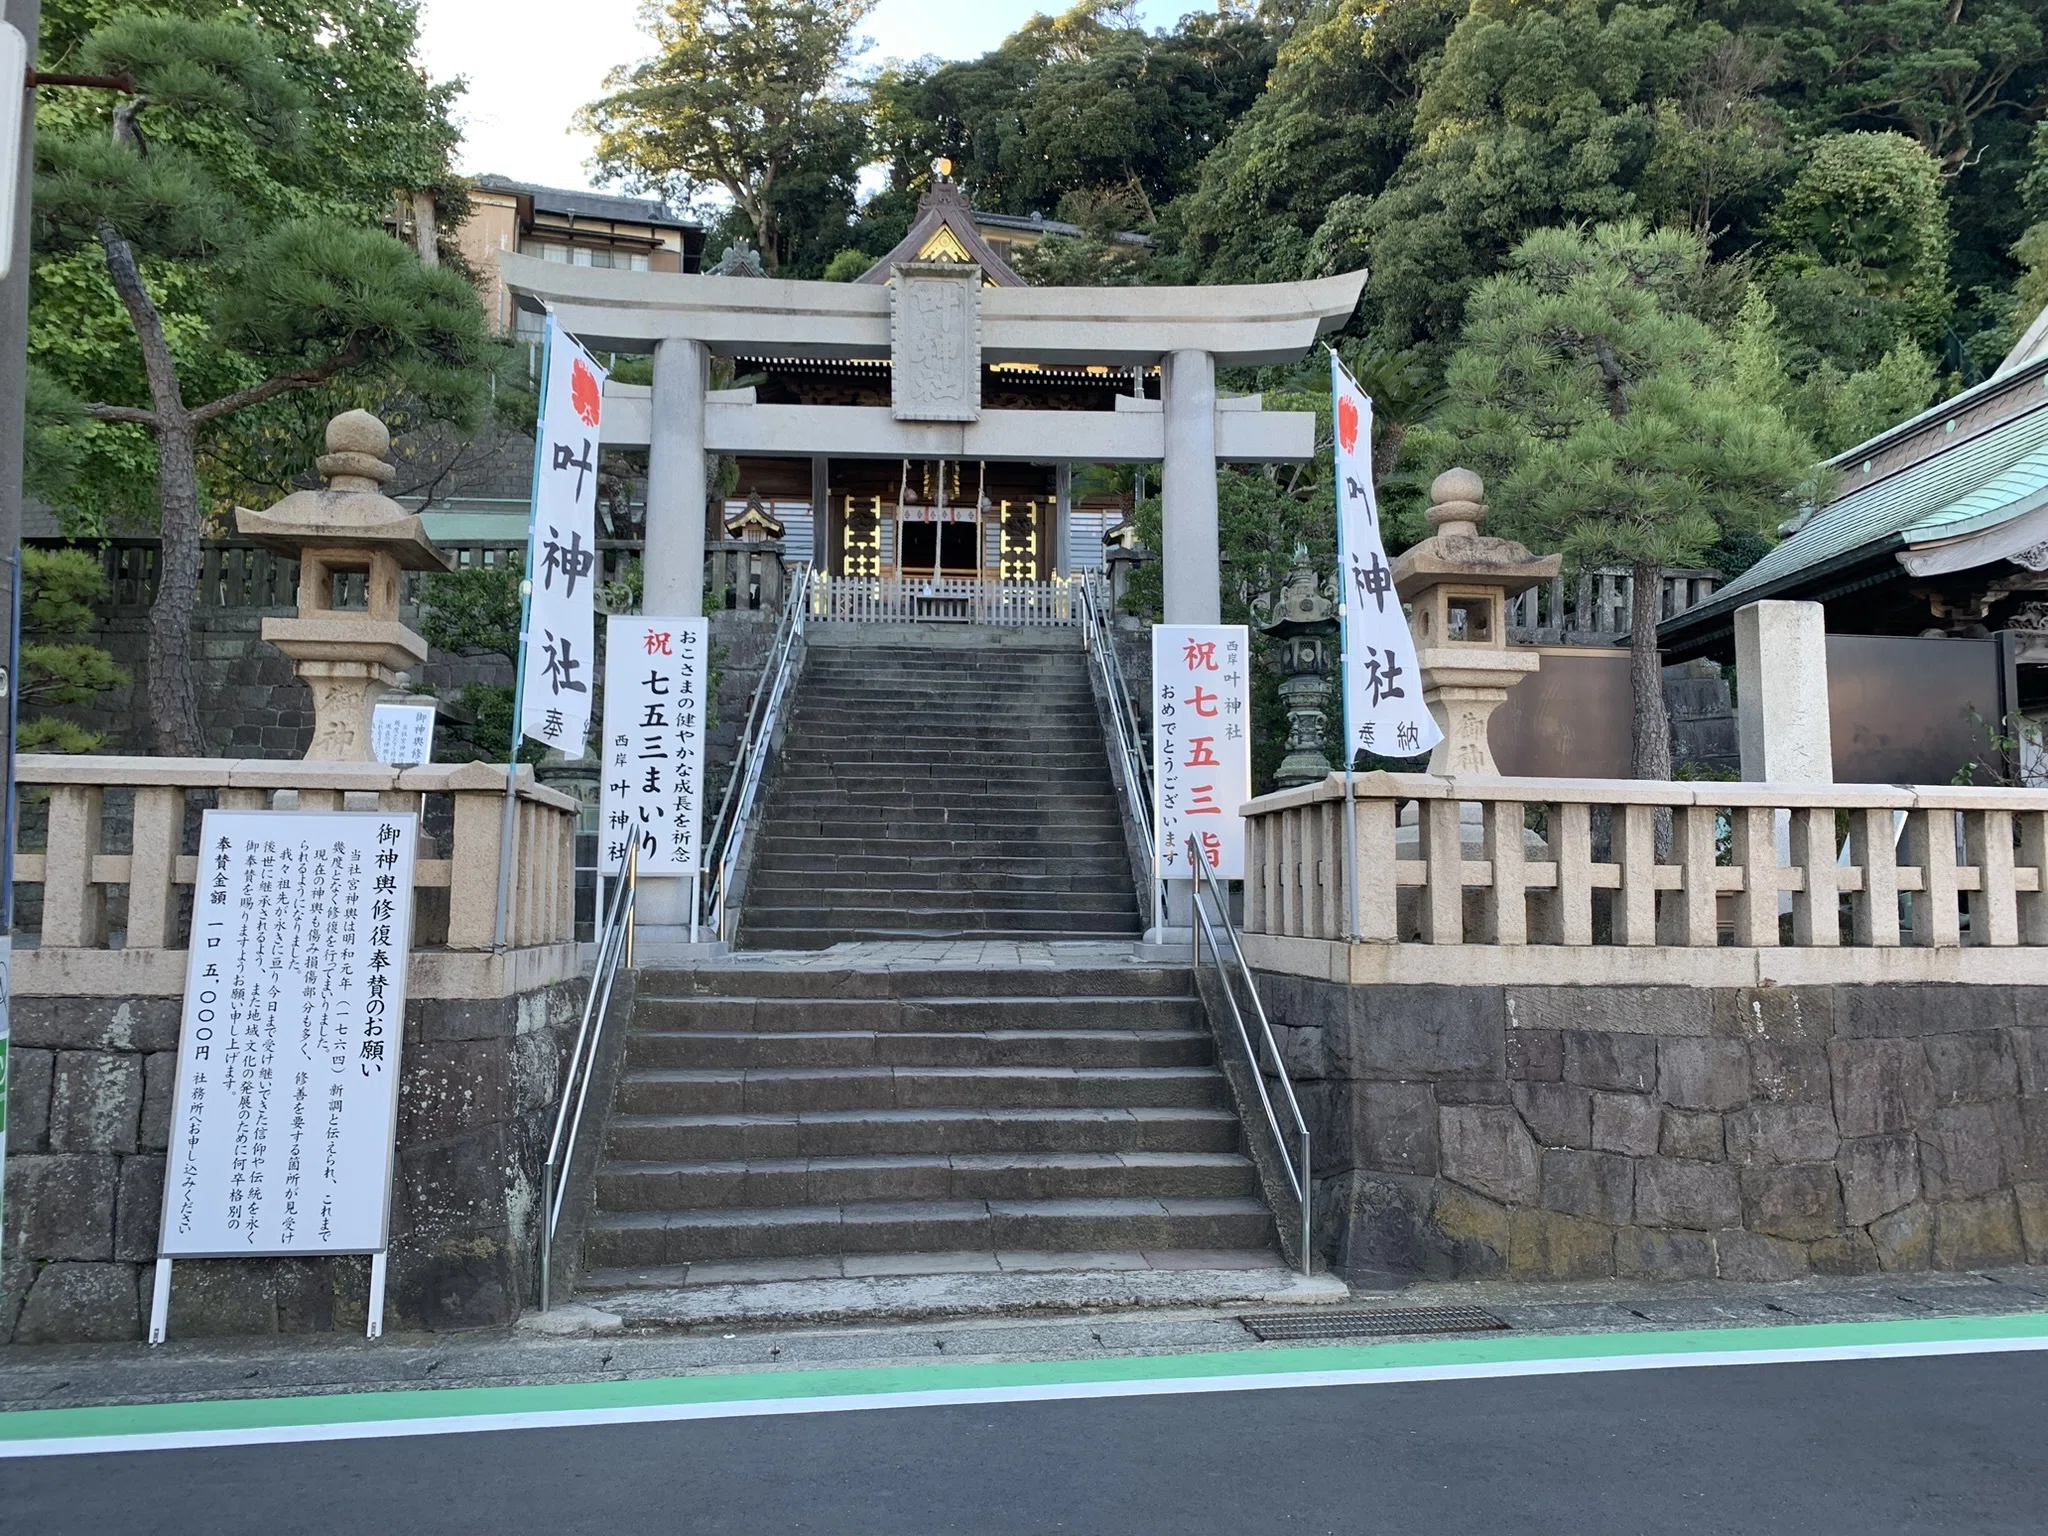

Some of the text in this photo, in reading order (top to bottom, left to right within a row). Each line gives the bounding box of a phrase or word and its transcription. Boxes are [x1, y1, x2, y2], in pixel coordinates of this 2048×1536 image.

[541, 438, 594, 696] 叶神社
[1346, 475, 1406, 708] 叶神社
[411, 711, 427, 763] 御神輿修
[671, 630, 697, 863] おこさまの健やかな成長を祈念
[1161, 684, 1179, 866] おめでとうございます
[287, 839, 310, 975] られるようになりました。
[358, 823, 401, 1077] 御神輿修復奉賛のお願い
